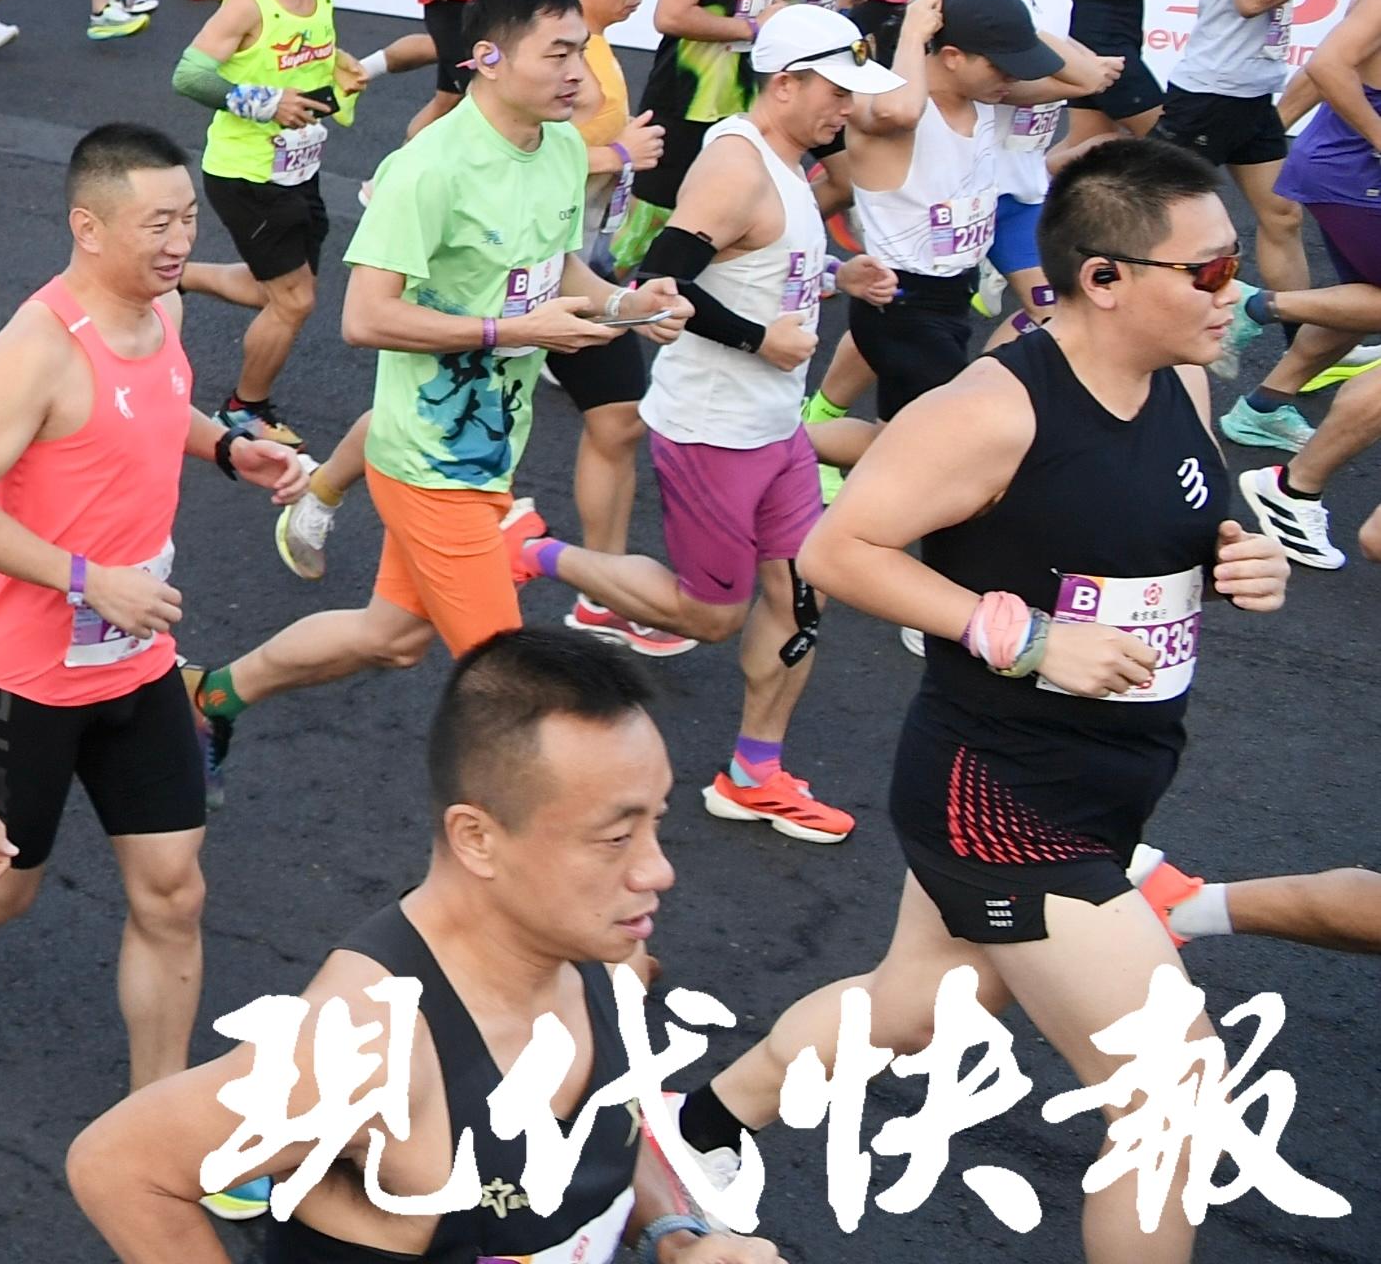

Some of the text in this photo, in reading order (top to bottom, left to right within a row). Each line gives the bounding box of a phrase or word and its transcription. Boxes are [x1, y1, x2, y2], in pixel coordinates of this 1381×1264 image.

[939, 206, 952, 225] B
[794, 256, 805, 276] B
[515, 273, 528, 292] B
[1072, 585, 1098, 612] B
